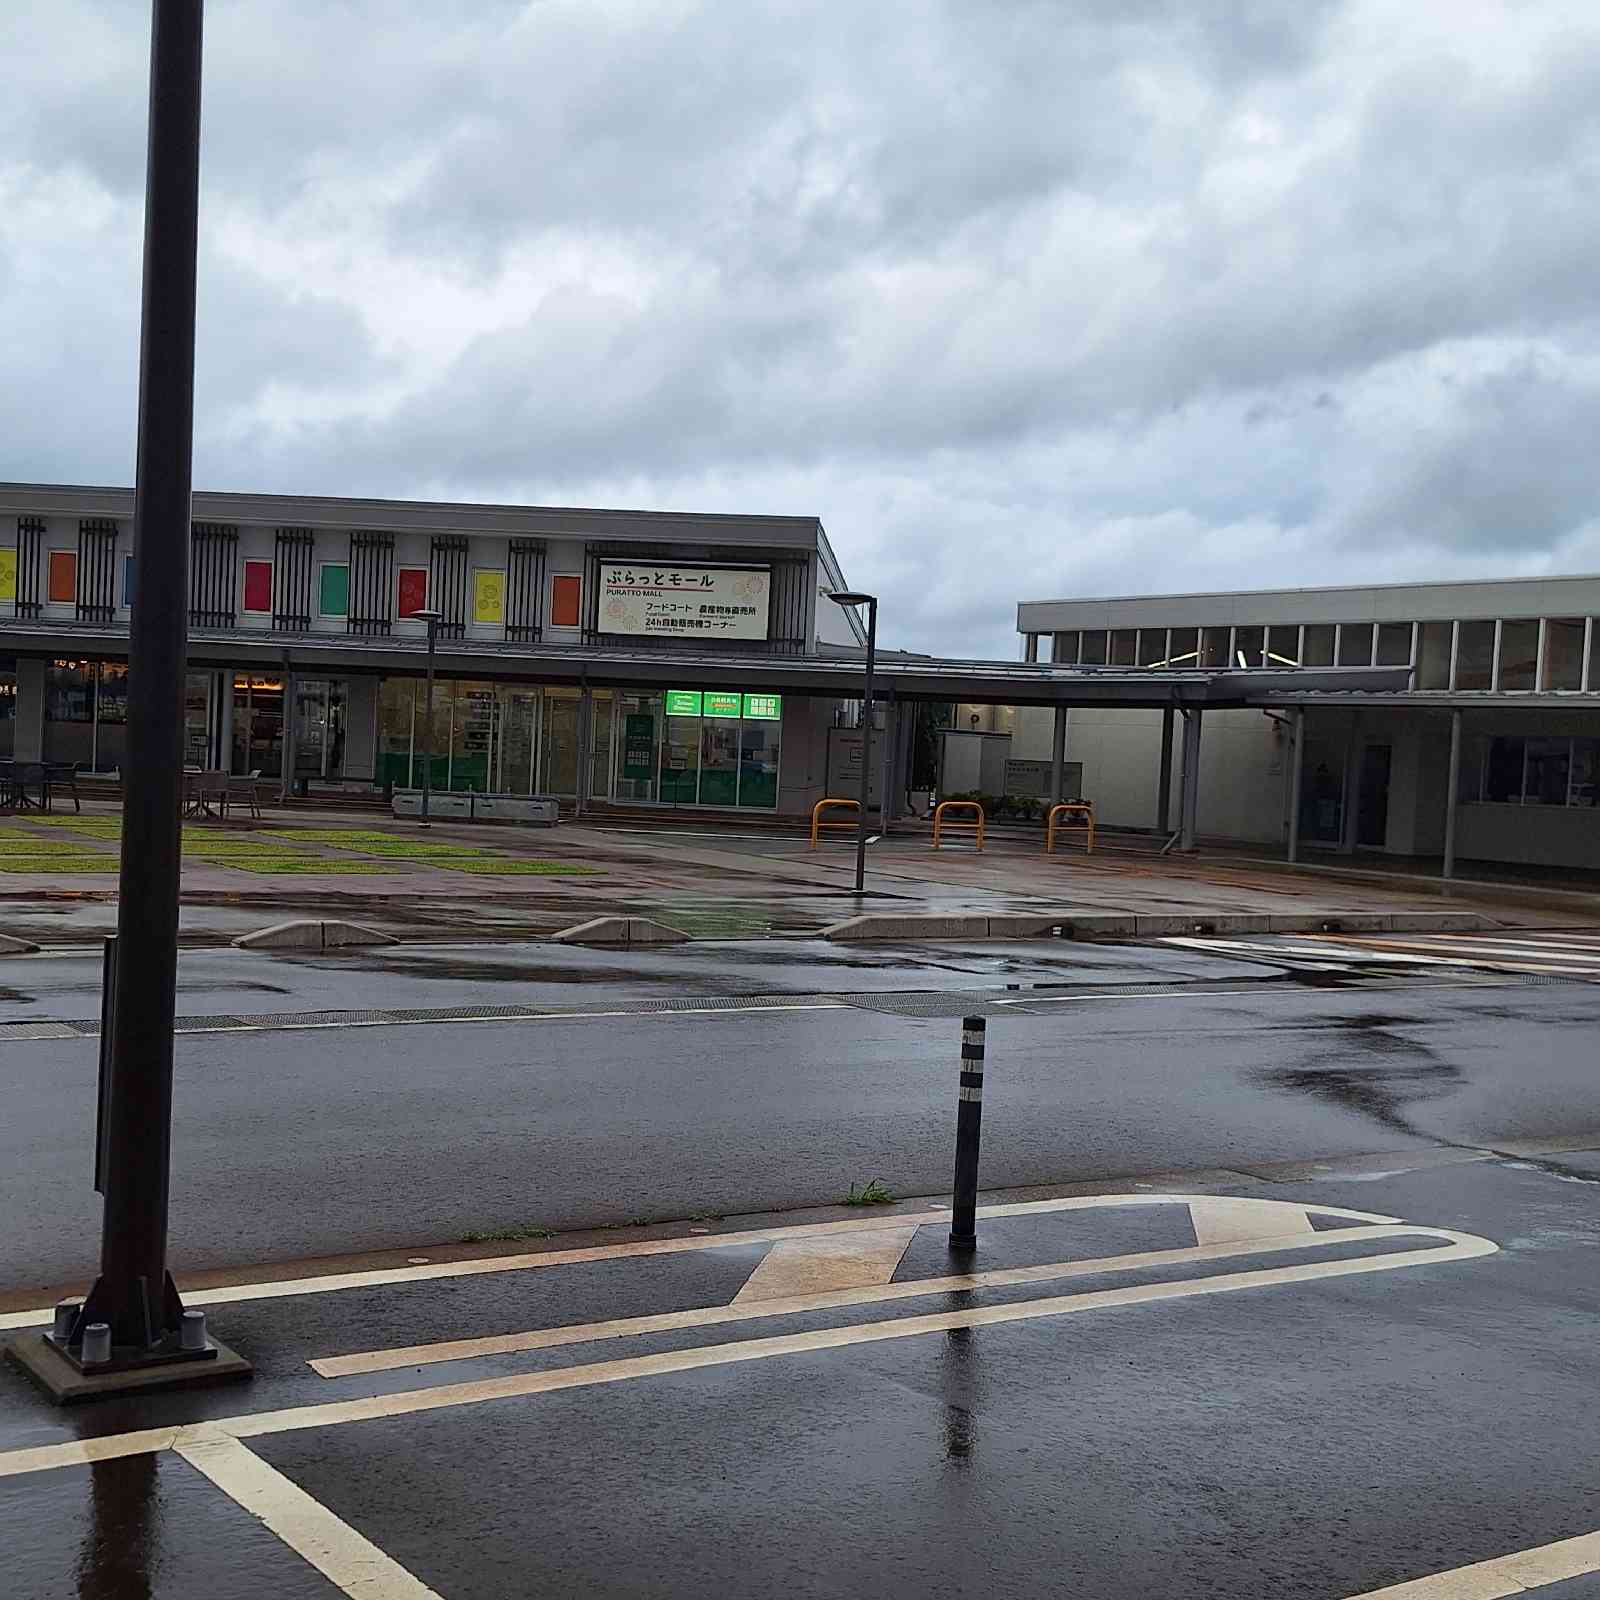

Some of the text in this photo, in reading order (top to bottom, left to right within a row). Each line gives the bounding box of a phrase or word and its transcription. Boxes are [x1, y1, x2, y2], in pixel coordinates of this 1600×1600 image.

[607, 570, 715, 587] ぷらっとモール
[606, 589, 663, 598] PURATTO MALL
[646, 602, 694, 612] フードコート
